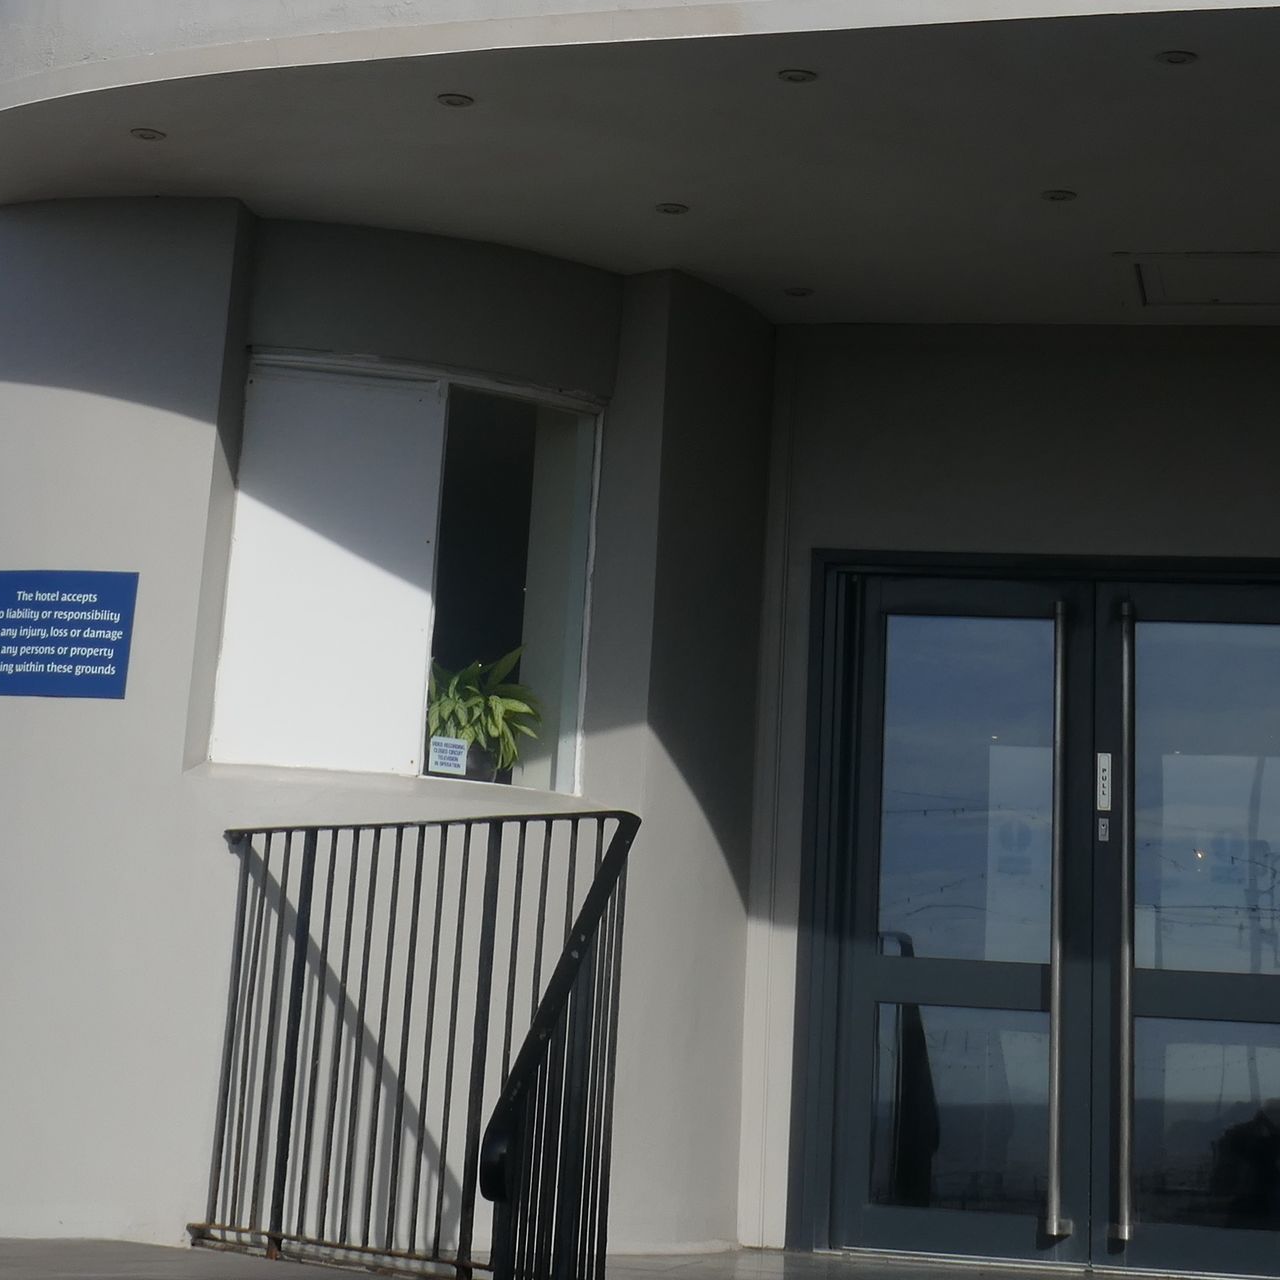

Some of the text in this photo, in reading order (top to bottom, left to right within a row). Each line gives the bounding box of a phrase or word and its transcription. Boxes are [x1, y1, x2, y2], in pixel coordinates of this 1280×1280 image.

[17, 591, 97, 604] The hotel accepts
[6, 609, 39, 621] liability
[42, 610, 51, 618] or
[54, 610, 120, 623] responsibility
[1, 629, 17, 638] any
[20, 627, 49, 639] injury,
[50, 627, 67, 637] loss
[70, 629, 81, 637] or
[83, 628, 123, 641] damage
[1, 647, 18, 656] any
[20, 646, 55, 656] persons
[57, 647, 67, 655] or
[70, 647, 114, 659] property
[16, 661, 44, 672] within
[47, 662, 72, 673] these
[75, 664, 116, 675] grounds
